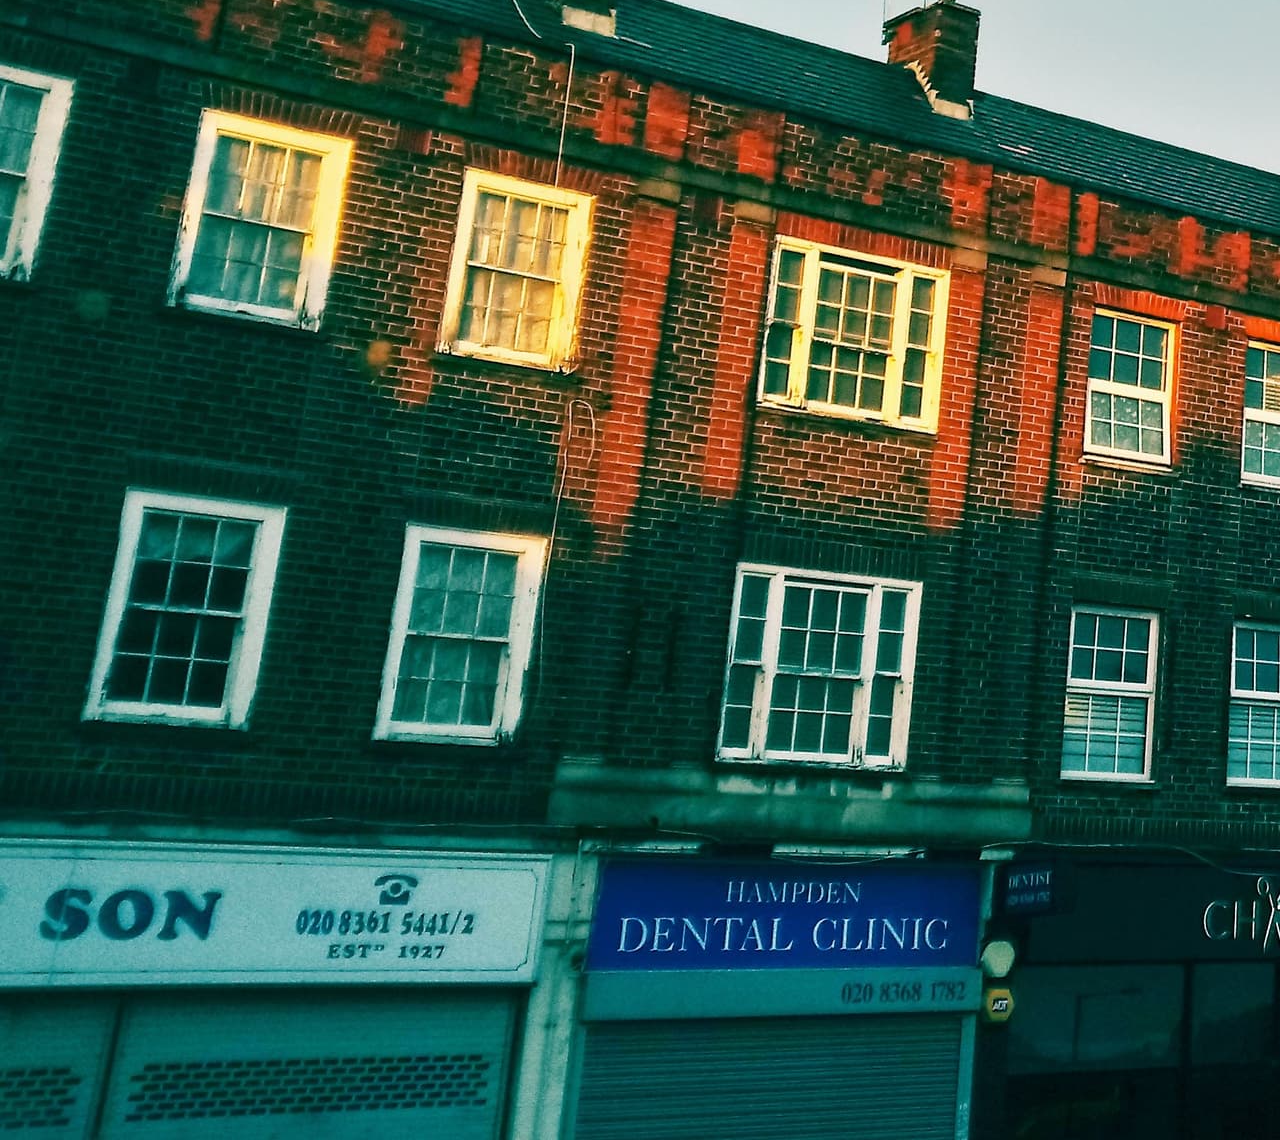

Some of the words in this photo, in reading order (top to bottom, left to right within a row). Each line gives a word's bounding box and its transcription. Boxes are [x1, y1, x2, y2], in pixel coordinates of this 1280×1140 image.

[726, 880, 863, 904] HAMPDEN
[1008, 871, 1052, 889] DENTIST
[39, 888, 222, 941] SON
[296, 909, 335, 936] 020
[338, 909, 391, 935] 8361
[400, 909, 475, 937] 5441/2
[616, 916, 795, 953] DENTAL
[812, 917, 949, 951] CLINIC
[397, 944, 445, 959] 1927
[841, 983, 873, 1004] 020
[879, 981, 923, 1003] 8368
[930, 979, 966, 1002] 1782
[991, 999, 1009, 1011] ADT
